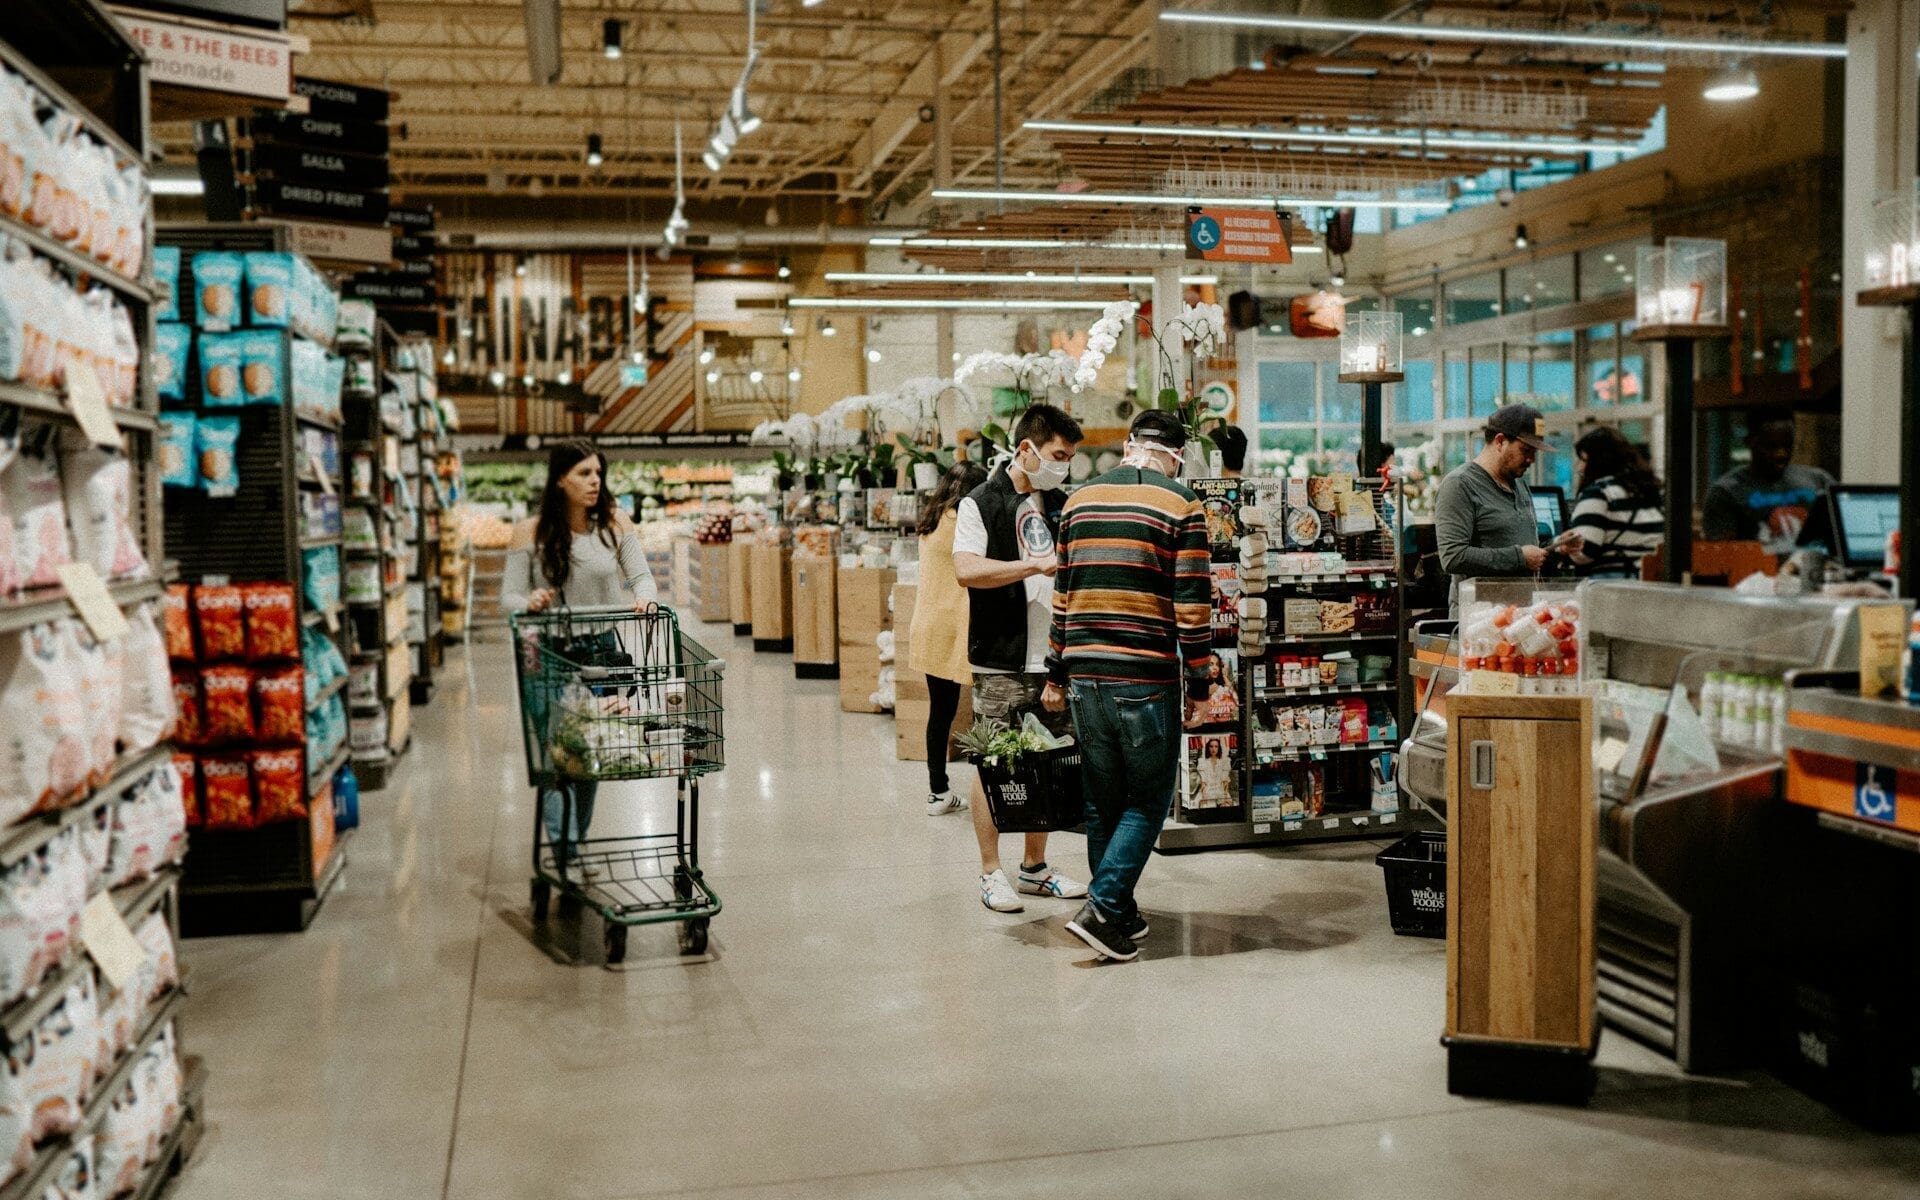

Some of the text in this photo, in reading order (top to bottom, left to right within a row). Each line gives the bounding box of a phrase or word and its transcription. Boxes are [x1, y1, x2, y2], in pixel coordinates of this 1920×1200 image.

[161, 31, 174, 50] &
[181, 34, 222, 58] THE
[229, 43, 277, 67] BEES
[302, 119, 343, 137] CHIPS
[302, 154, 345, 171] SALSA
[281, 183, 364, 207] DRIED FRUIT
[1690, 281, 1704, 324] 7
[1193, 482, 1238, 490] PLANT-BASED
[197, 594, 242, 611] dang
[246, 593, 291, 609] dang
[204, 675, 248, 692] dang
[256, 677, 299, 694] dang
[203, 761, 247, 777] dang
[254, 755, 298, 773] dang
[1000, 784, 1026, 792] WHOLE
[1002, 792, 1028, 800] FOODS
[1411, 889, 1446, 900] WHOLE
[1413, 898, 1445, 908] FOODS
